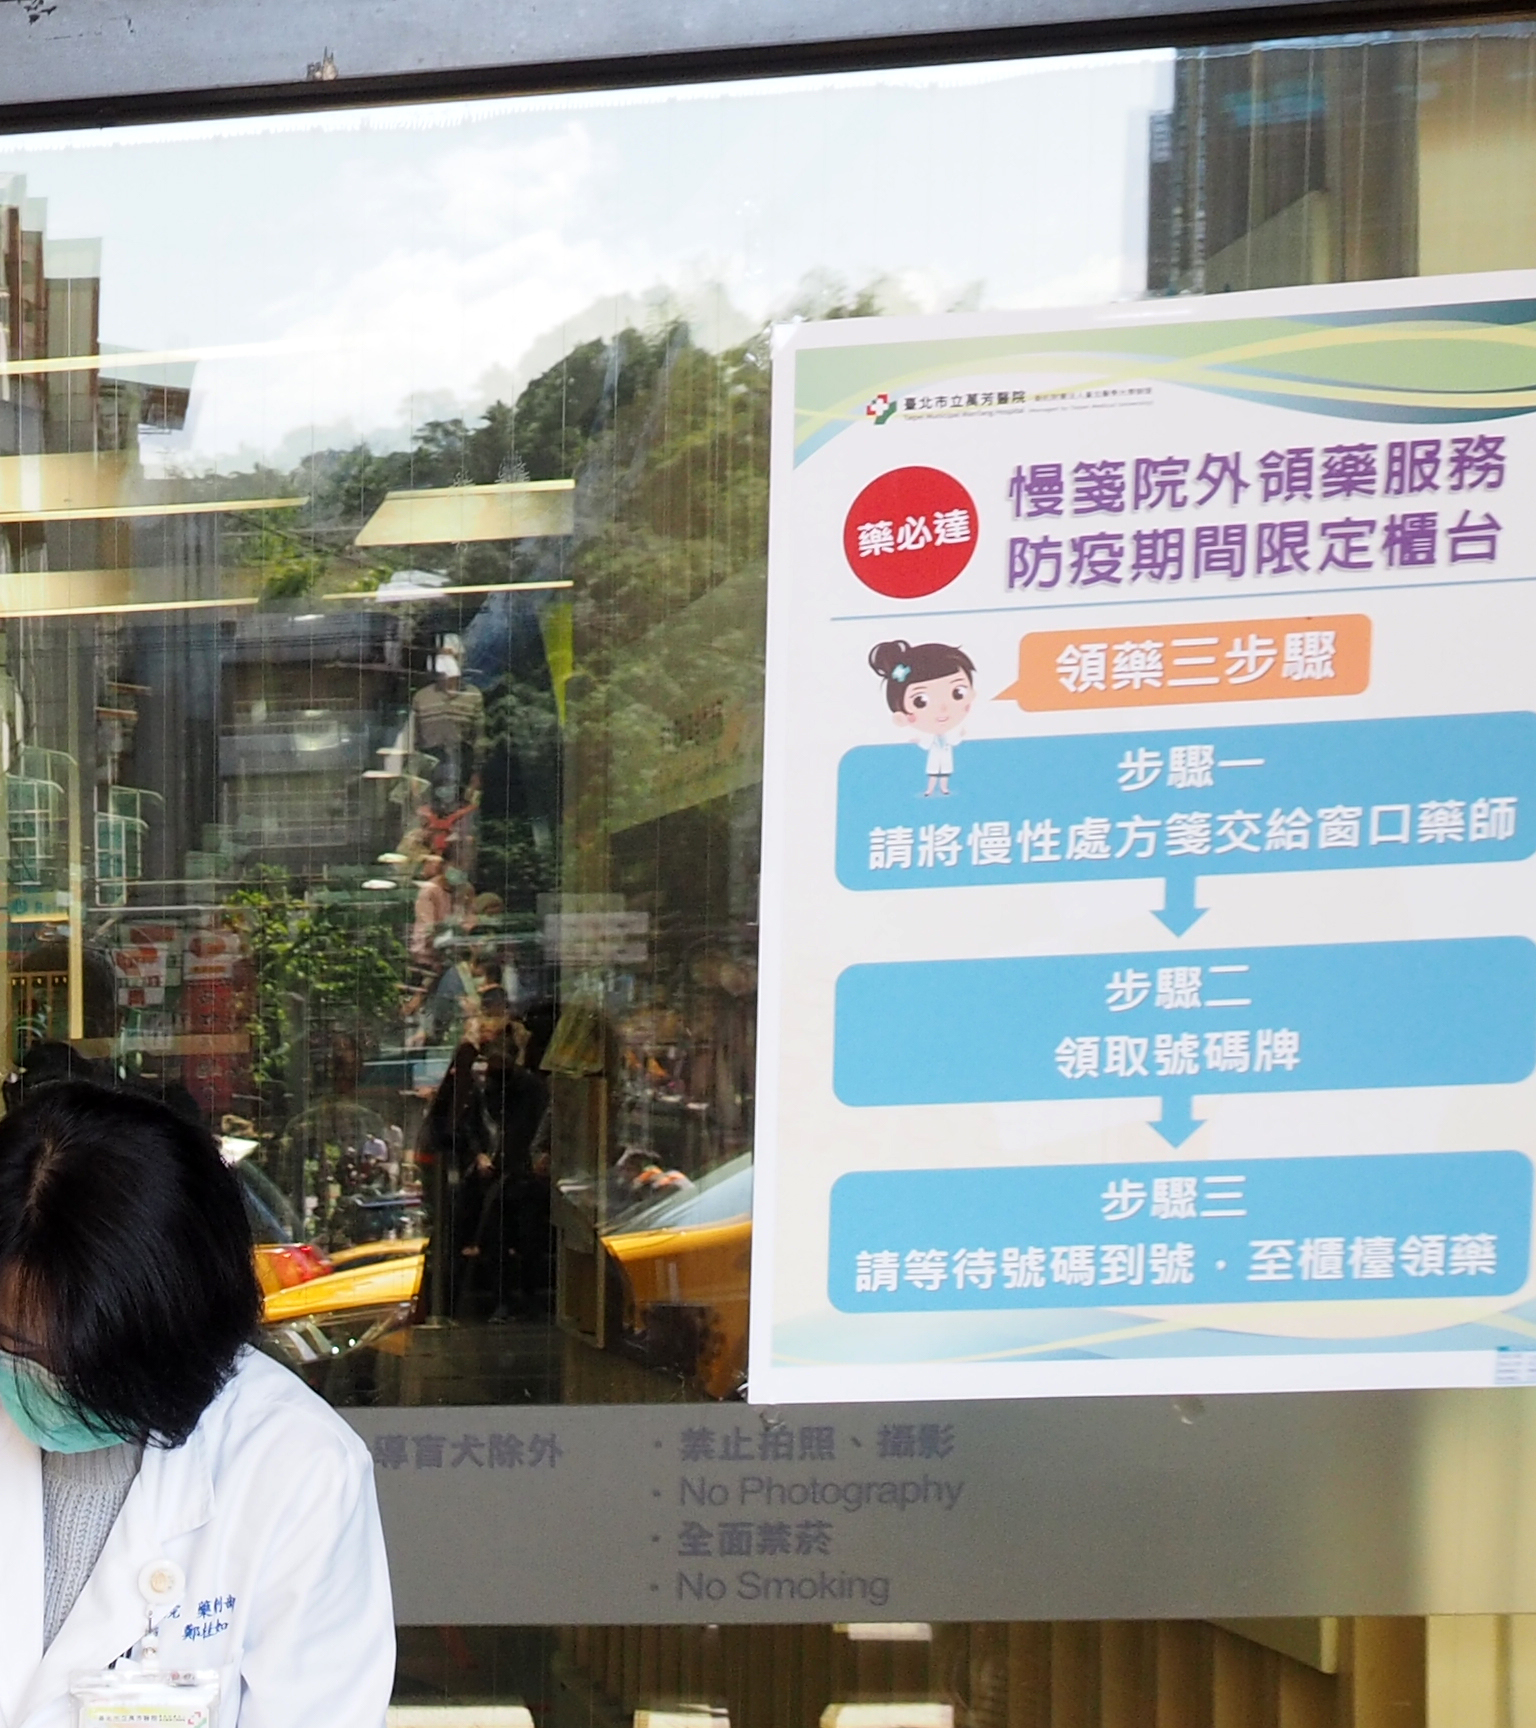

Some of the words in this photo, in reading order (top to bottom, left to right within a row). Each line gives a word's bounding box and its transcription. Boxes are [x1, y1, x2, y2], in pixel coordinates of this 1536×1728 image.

[903, 390, 1026, 411] 臺北市立萬芳醫院
[1008, 433, 1510, 519] 慢箋院外領藥服務
[856, 507, 972, 558] 藥必達
[1006, 508, 1503, 592] 防疫期間限定櫃台
[1057, 631, 1337, 695] 領藥三步驟
[1116, 742, 1265, 792] 步驟一
[868, 797, 1518, 872] 請將慢性處方箋交給窗口藥師
[1103, 962, 1252, 1013] 步驟二
[1054, 1027, 1302, 1081] 領取號碼牌
[1100, 1171, 1249, 1221] 步驟三
[679, 1423, 956, 1462] 禁止拍照、攝影
[679, 1477, 731, 1506] No
[739, 1473, 964, 1514] Photography
[678, 1520, 833, 1557] 全面禁菸
[676, 1572, 728, 1600] No
[737, 1570, 891, 1607] Smoking
